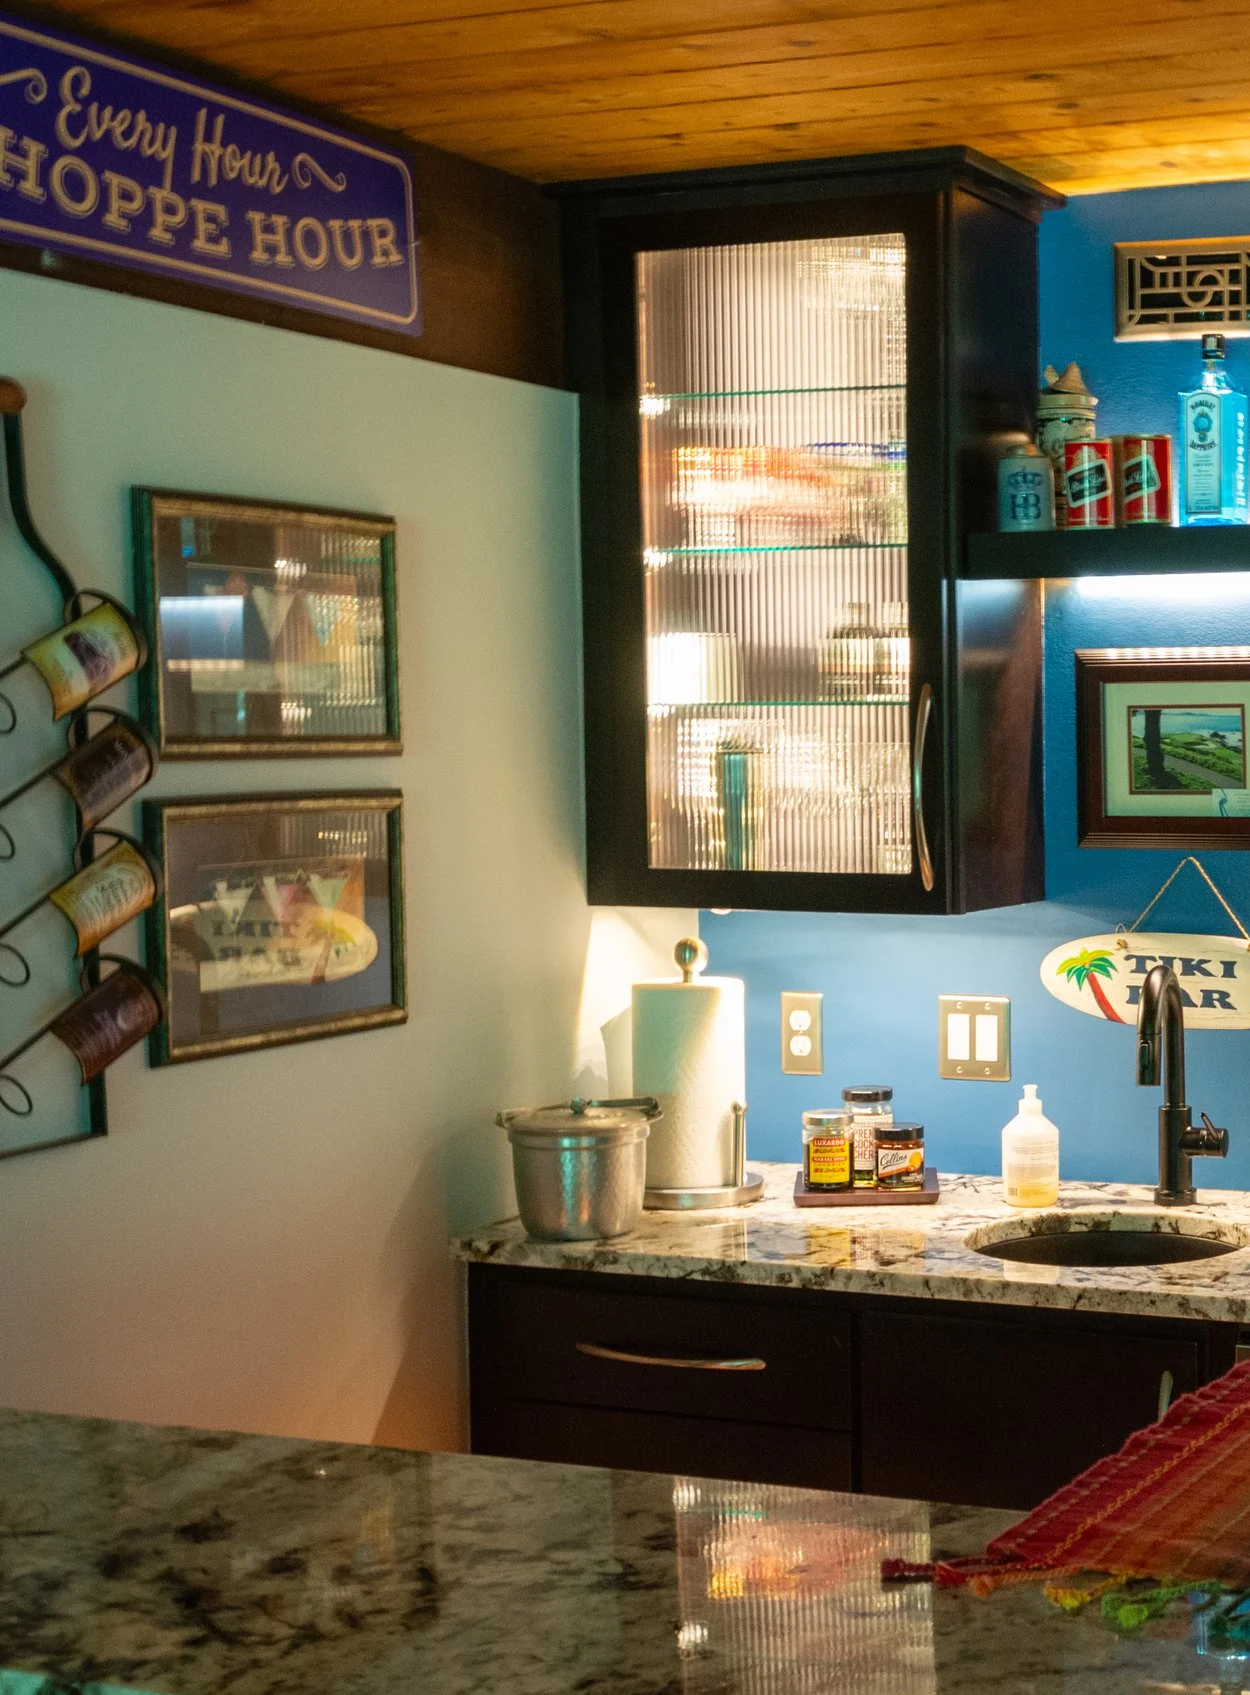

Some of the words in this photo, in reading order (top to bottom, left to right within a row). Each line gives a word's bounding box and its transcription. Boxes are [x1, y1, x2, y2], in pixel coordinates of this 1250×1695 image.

[55, 65, 178, 191] Every
[190, 107, 290, 195] Hour
[0, 126, 232, 257] HOPPE
[245, 209, 405, 271] HOUR
[1124, 954, 1238, 979] TIKI
[814, 1138, 845, 1146] LUXARDO
[880, 1150, 907, 1170] Collins
